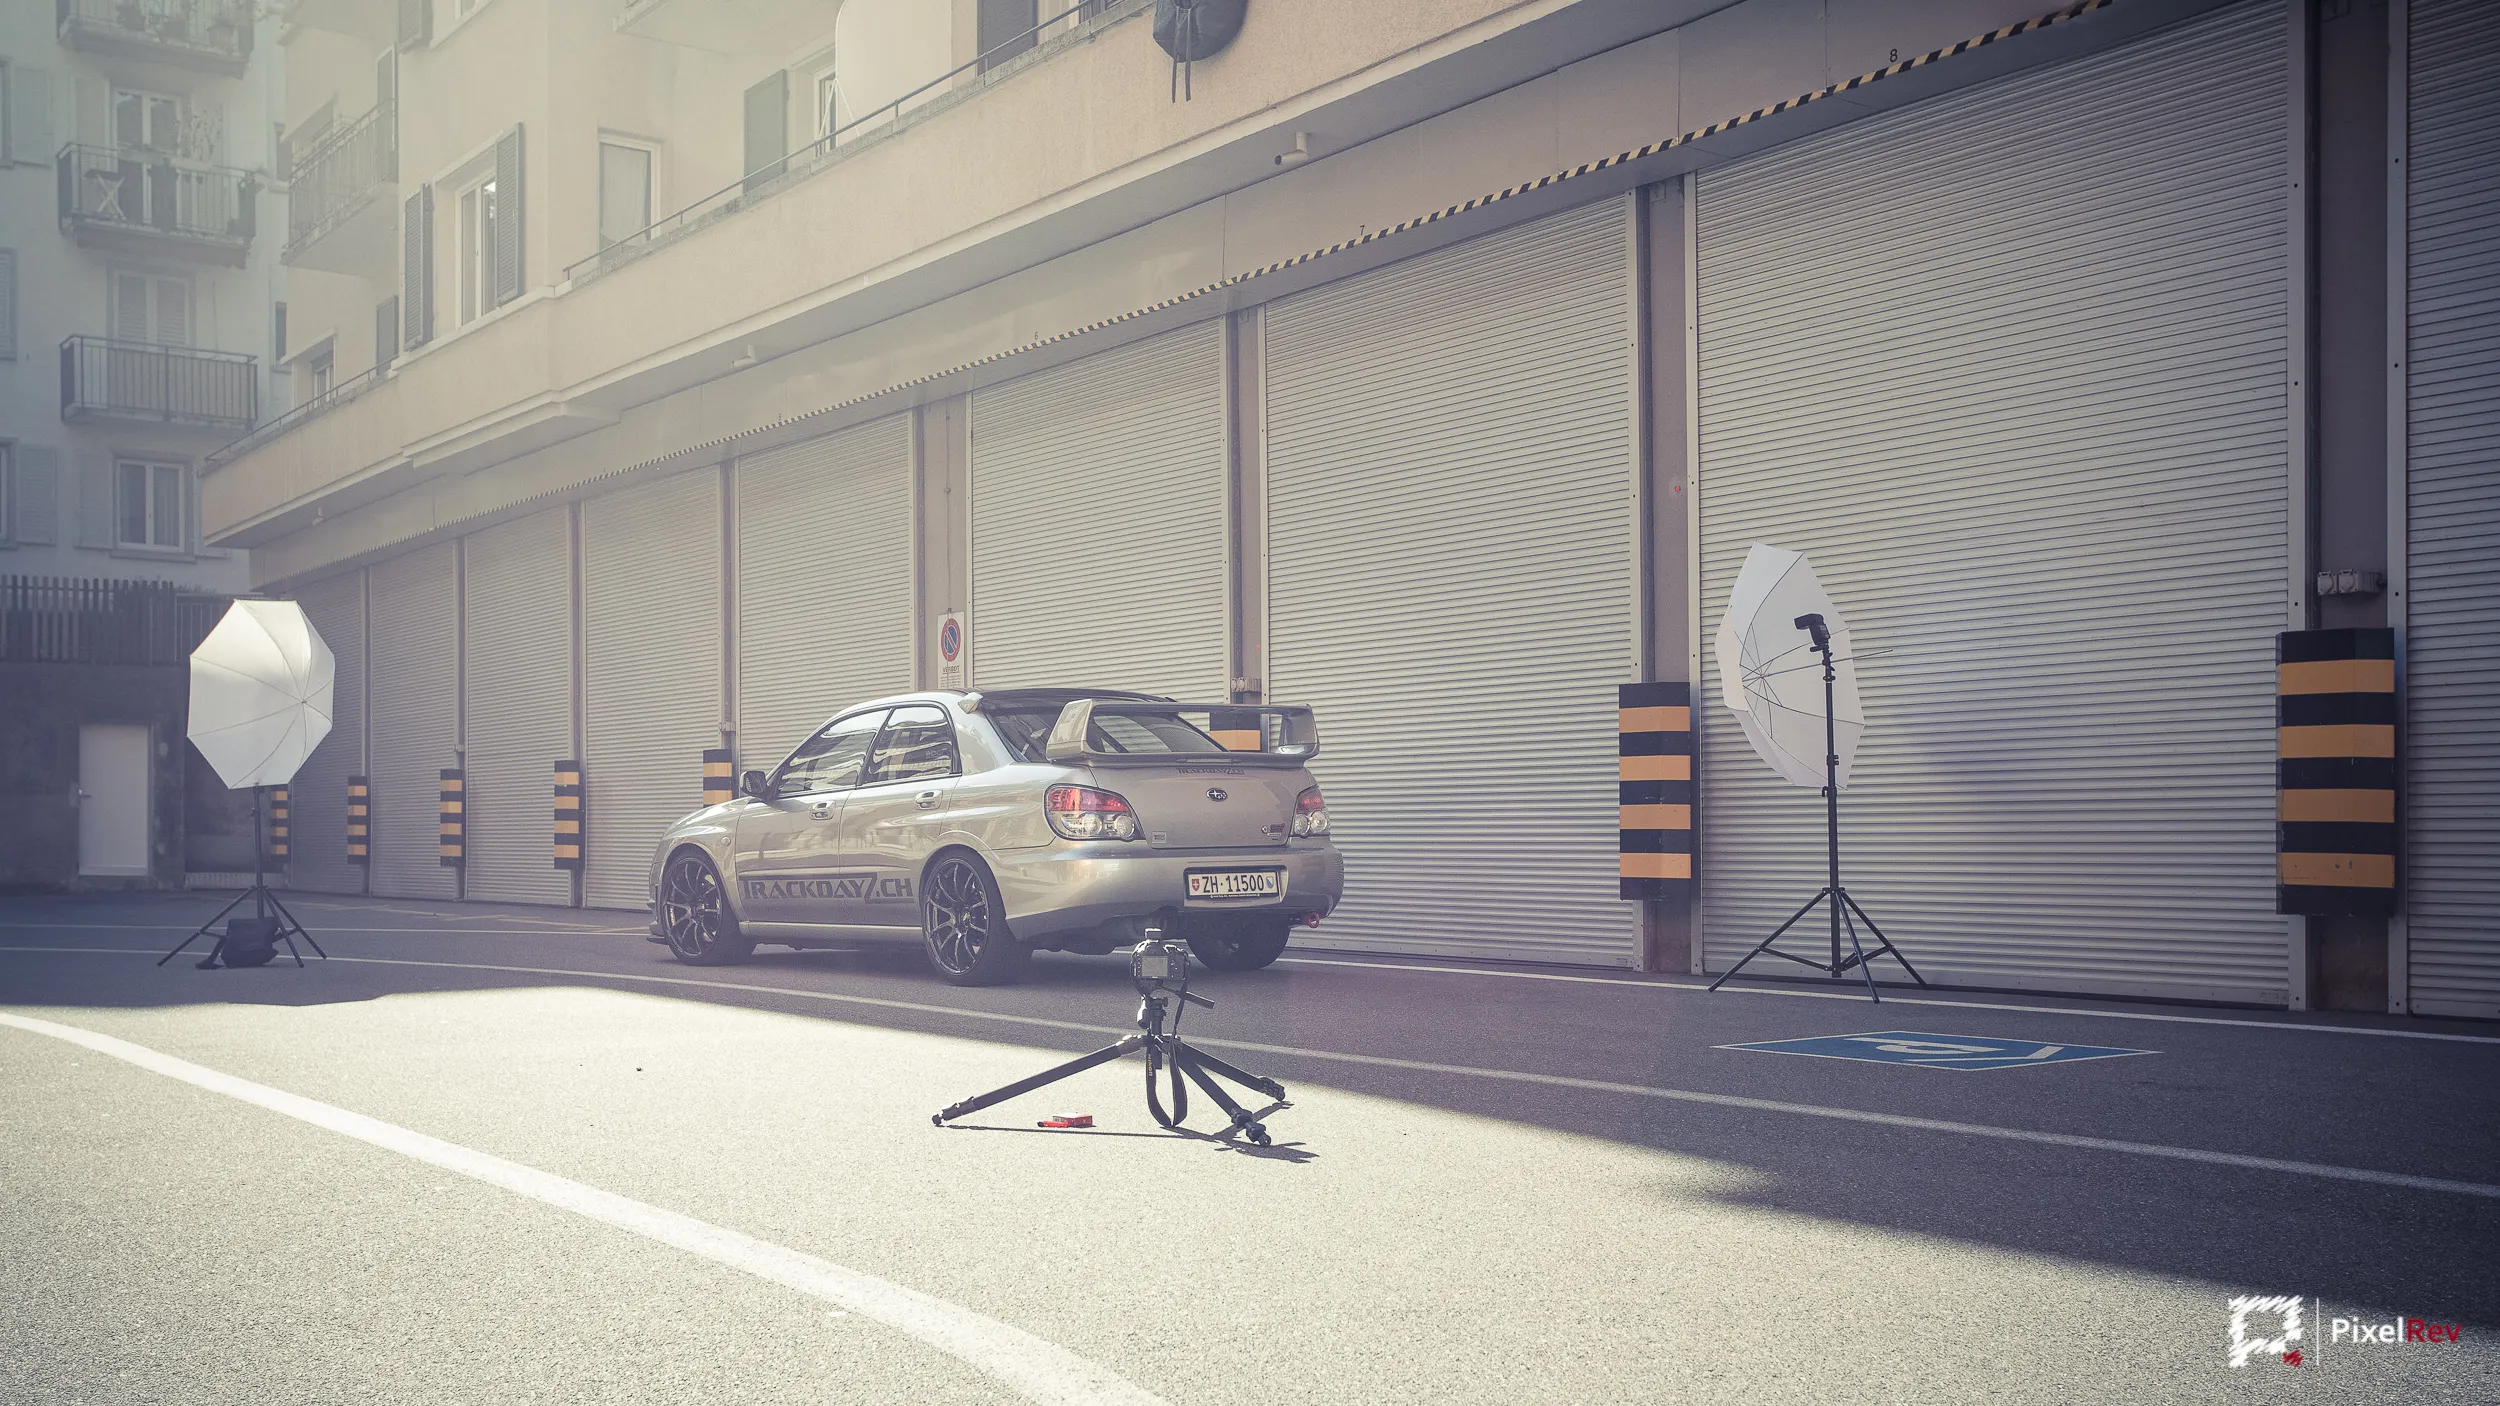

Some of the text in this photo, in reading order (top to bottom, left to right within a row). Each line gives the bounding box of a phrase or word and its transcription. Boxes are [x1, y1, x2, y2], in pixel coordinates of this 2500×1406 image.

[1889, 48, 1898, 62] 8
[1360, 225, 1365, 235] 7
[1034, 331, 1039, 340] 6
